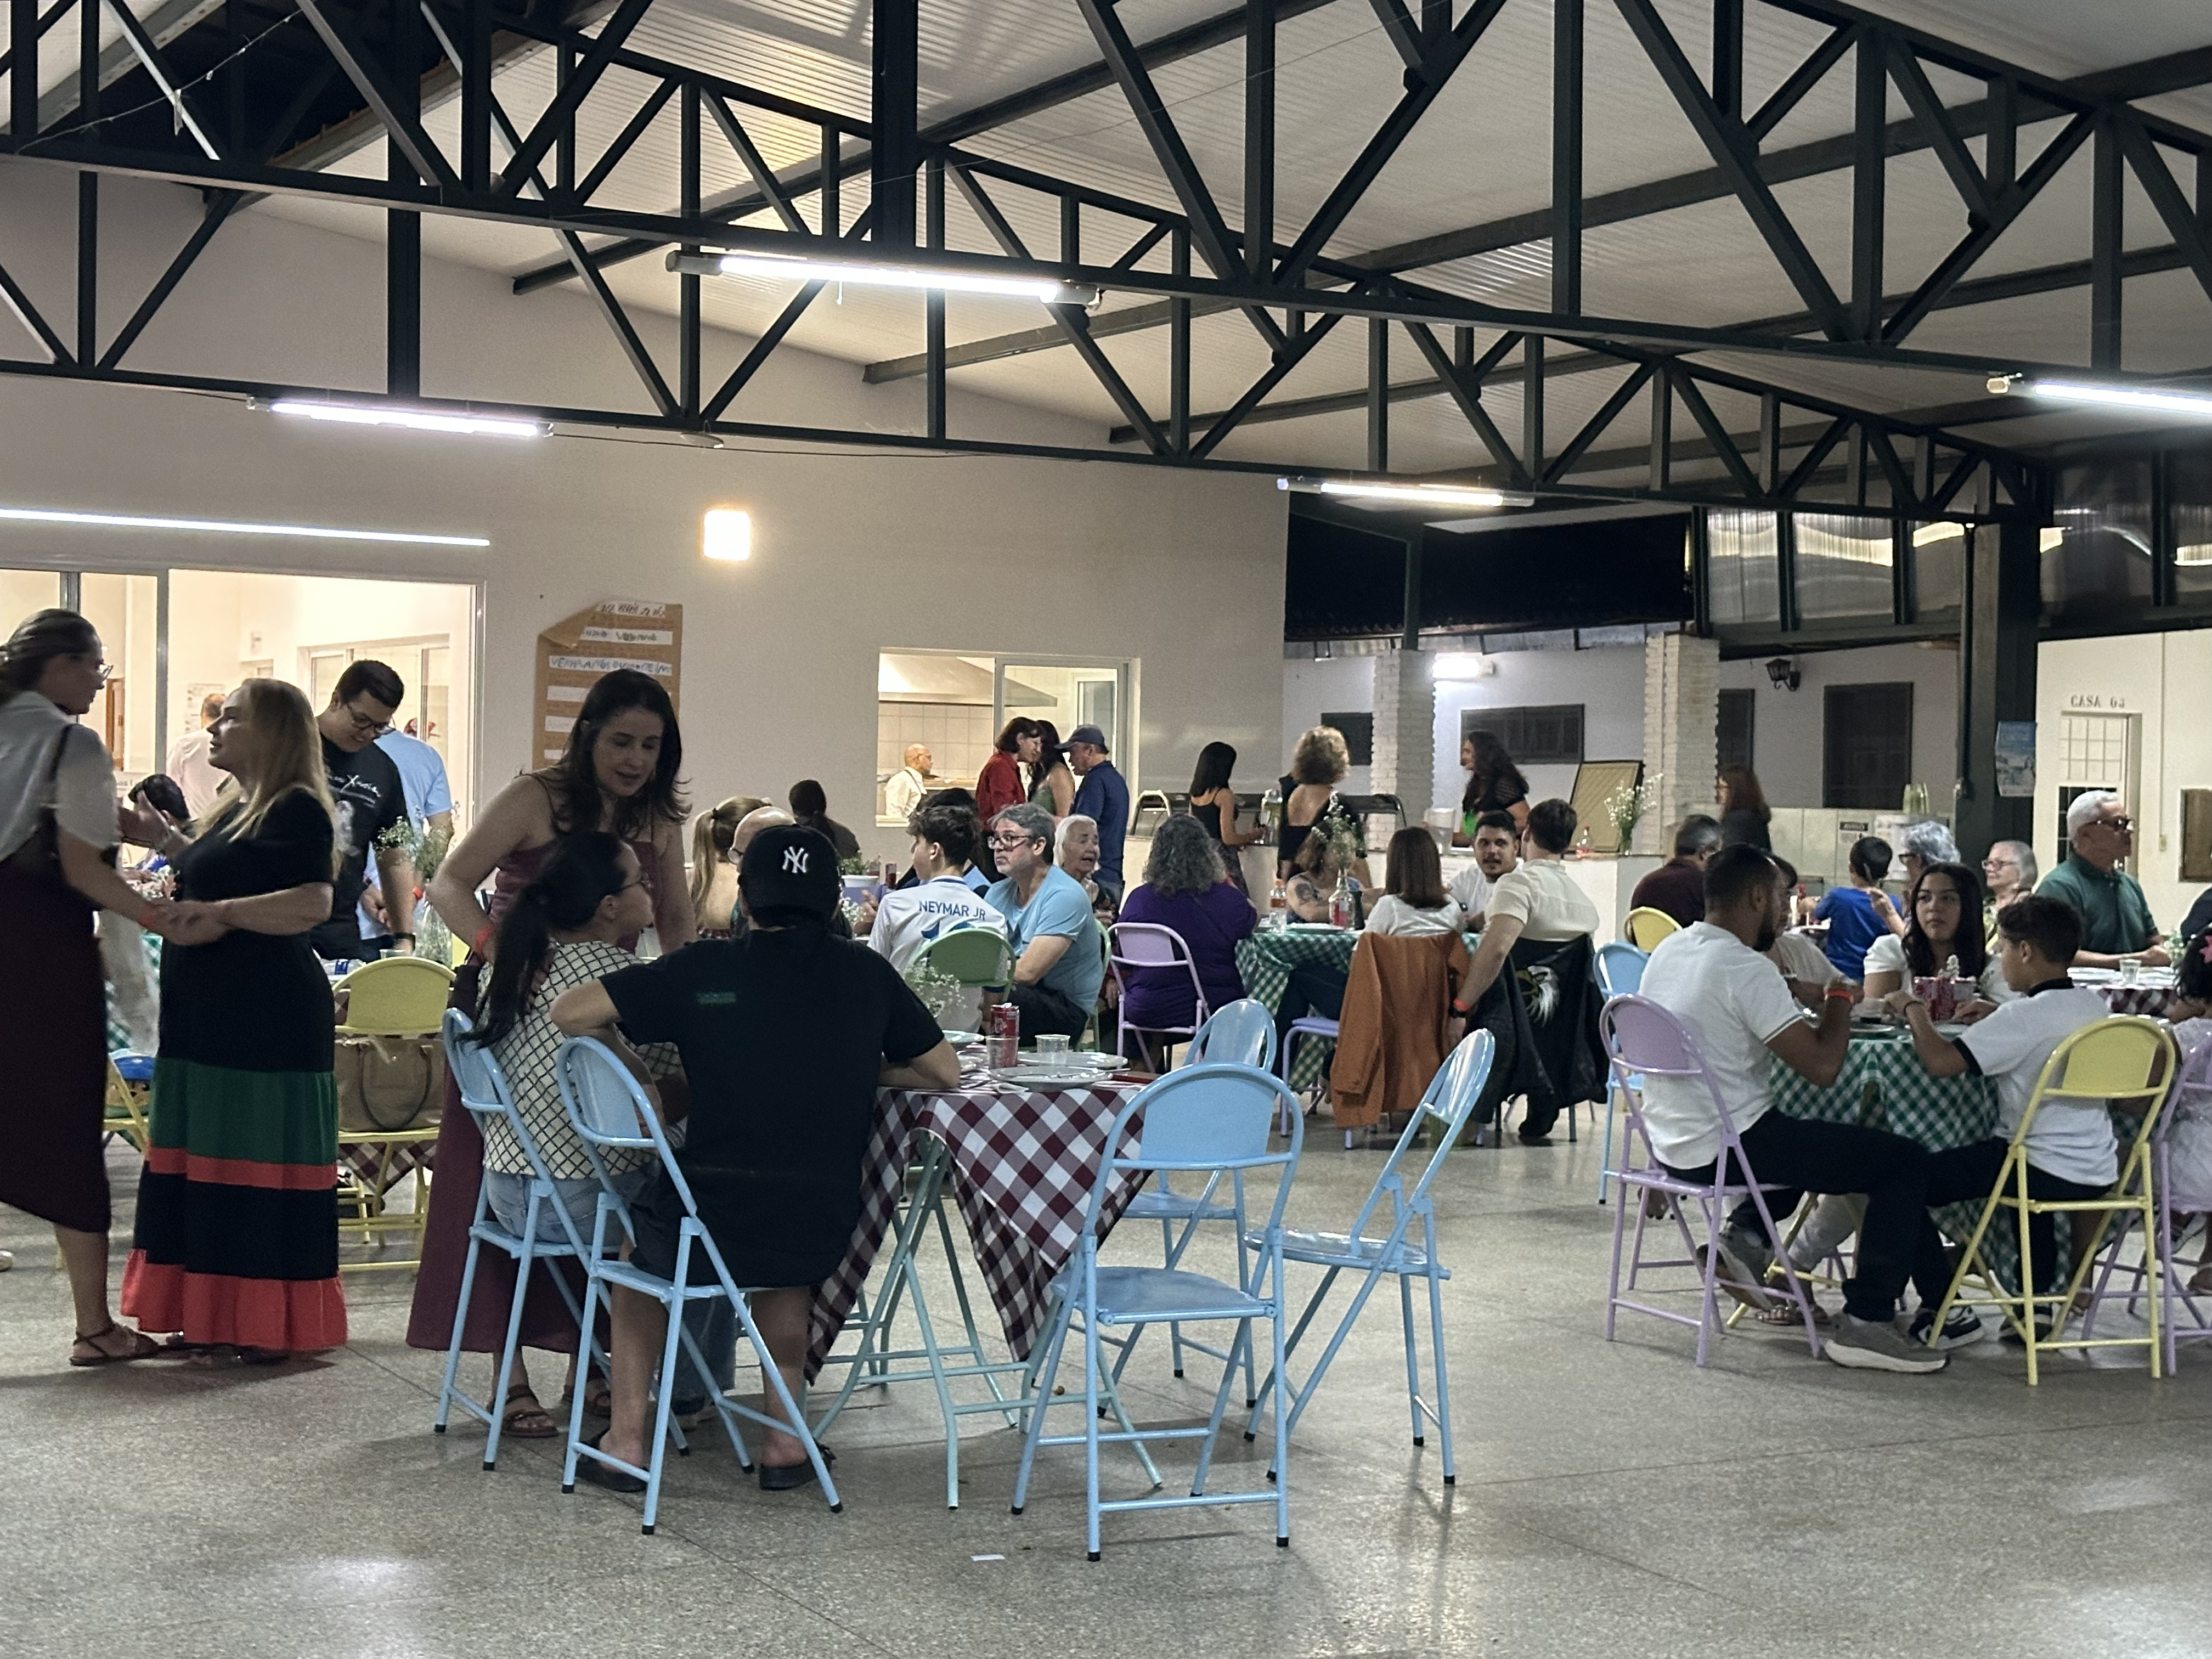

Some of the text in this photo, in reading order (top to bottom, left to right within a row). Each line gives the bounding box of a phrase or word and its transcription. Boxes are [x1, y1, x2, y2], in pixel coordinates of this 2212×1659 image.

[2070, 695, 2101, 708] CASA
[782, 847, 809, 873] NY
[918, 900, 986, 921] NEYMAR JR
